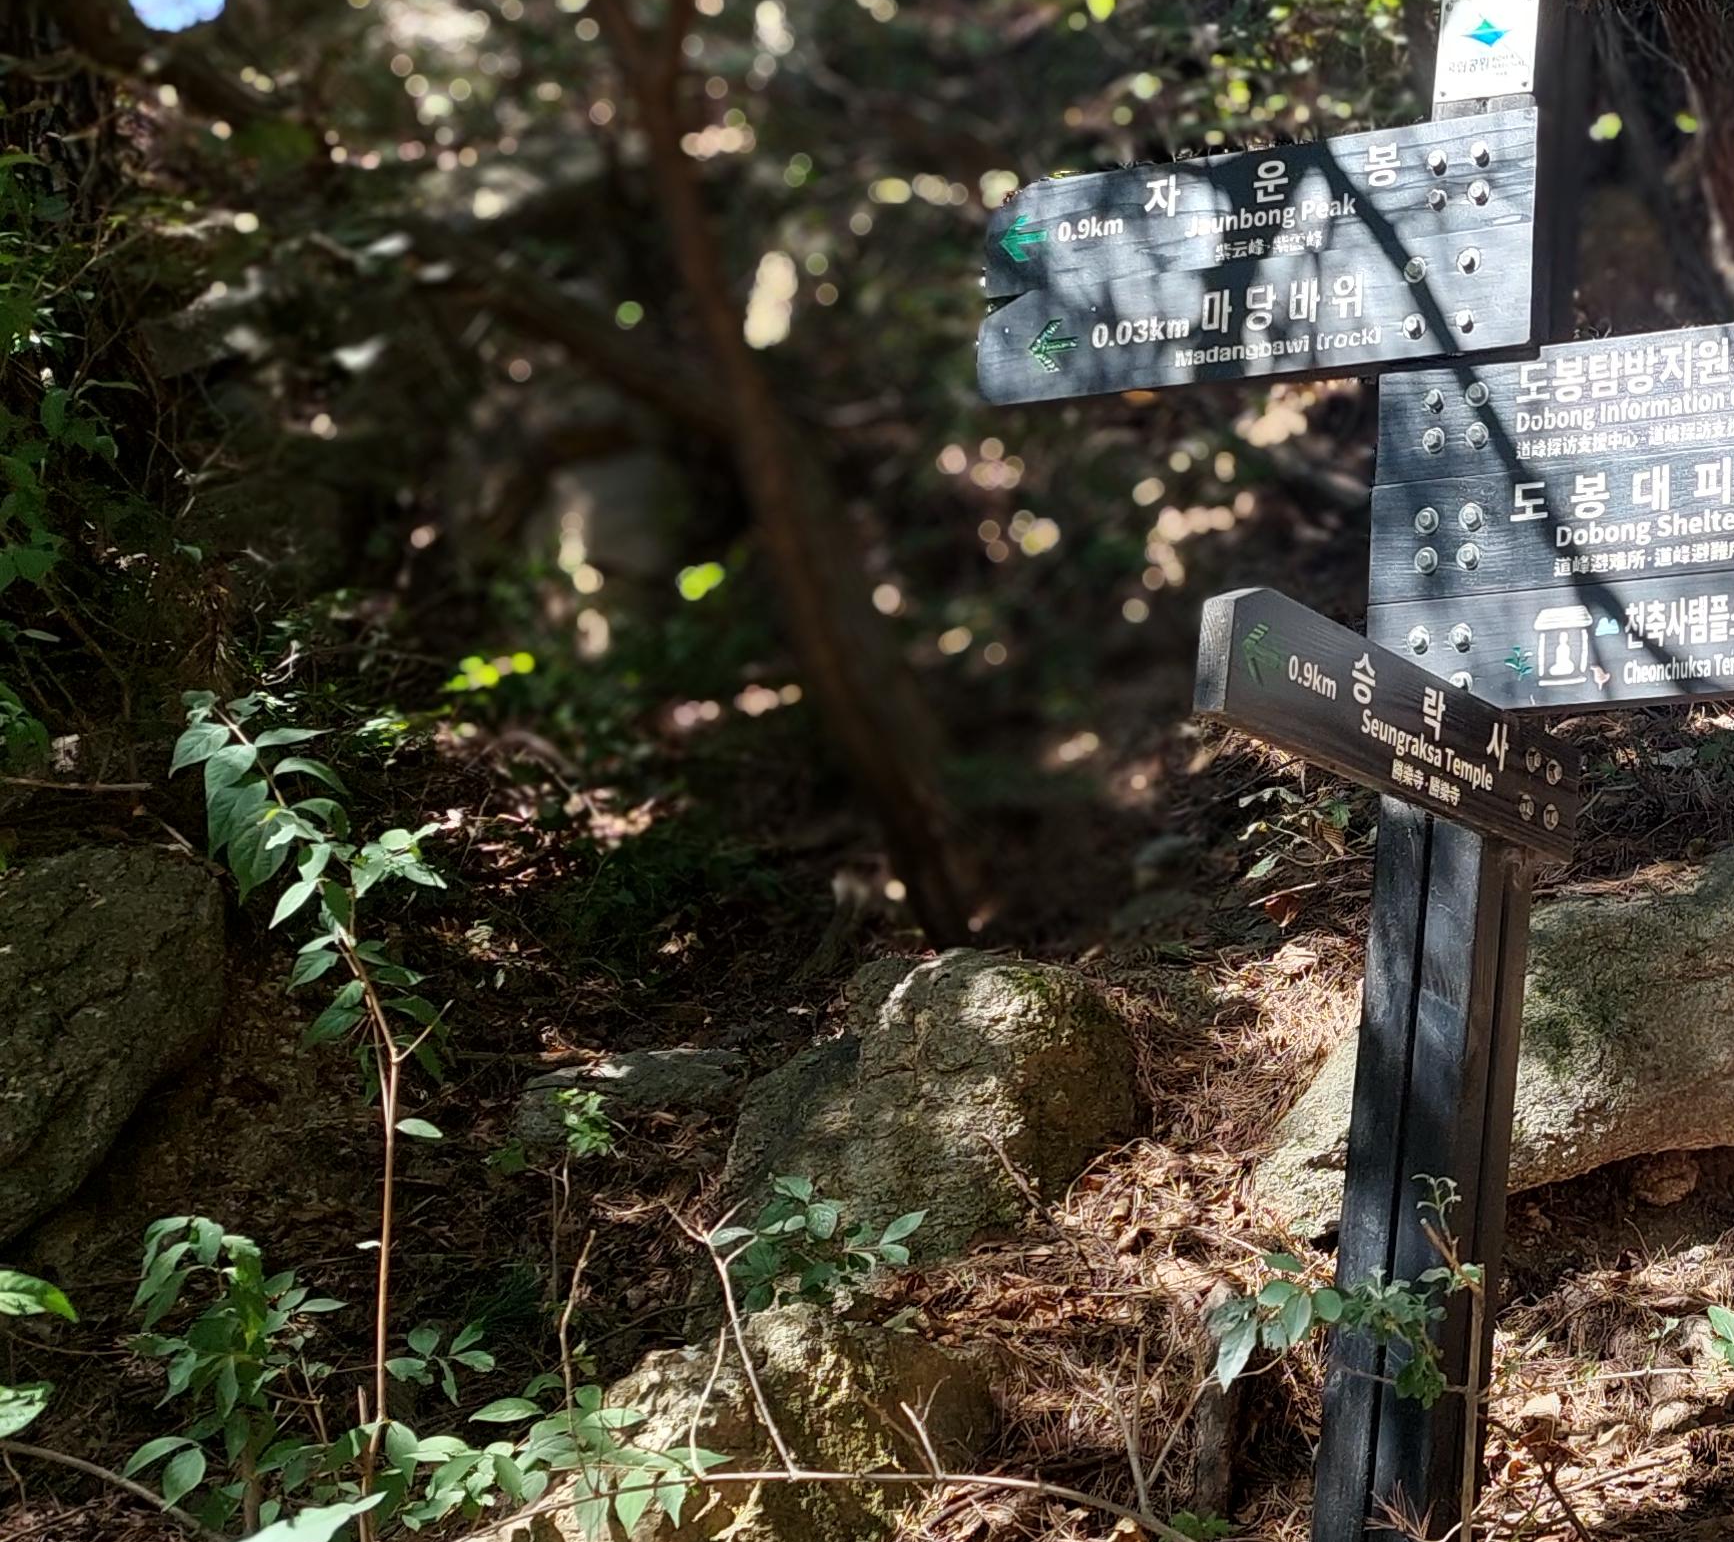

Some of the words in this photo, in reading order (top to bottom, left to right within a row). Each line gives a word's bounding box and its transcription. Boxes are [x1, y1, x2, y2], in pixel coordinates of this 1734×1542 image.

[1057, 217, 1124, 242] 0.9km
[1184, 206, 1296, 238] Jaunbong
[1301, 193, 1356, 221] Peak
[1091, 316, 1190, 348] 0.03km
[1201, 272, 1365, 334] 마당바위
[1174, 335, 1309, 368] Madangbawi
[1516, 406, 1596, 433] Dobong
[1600, 390, 1725, 424] Information
[1555, 520, 1651, 548] Dobong
[1288, 654, 1337, 701] 0.9km
[1623, 655, 1711, 685] Cheonchuksa
[1361, 708, 1442, 768] Seungraksa
[1445, 747, 1494, 791] Temple
